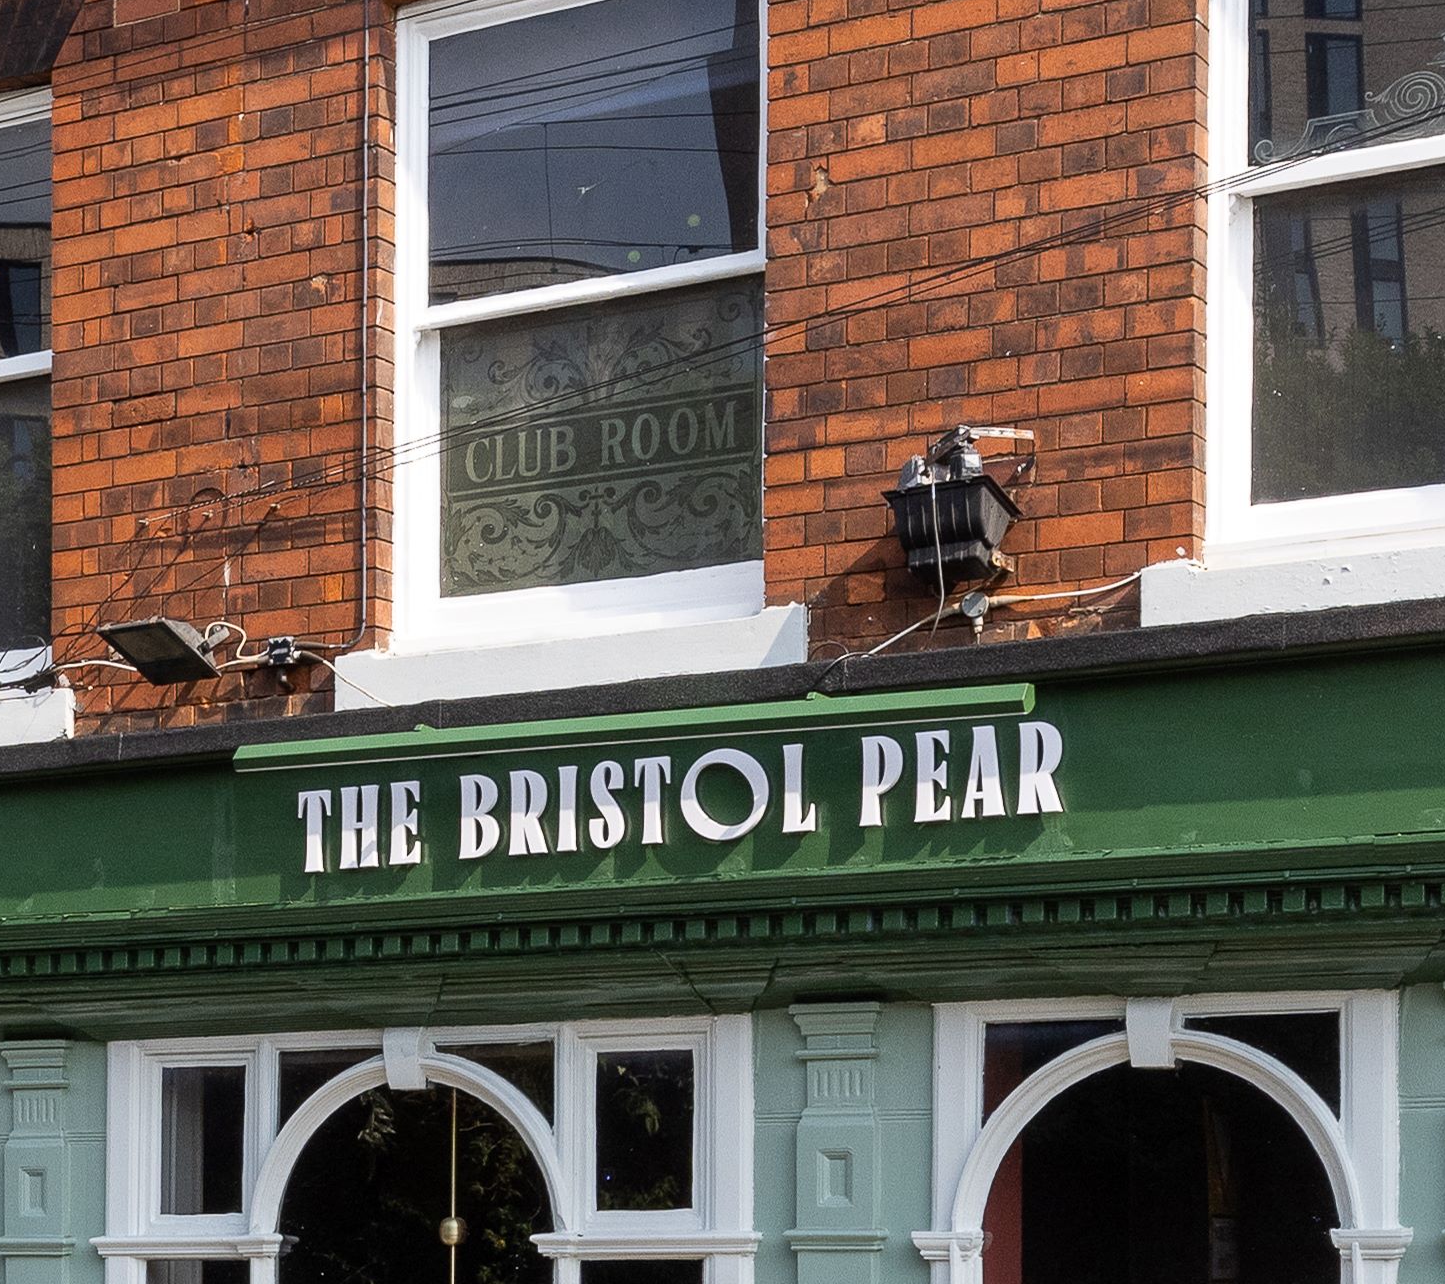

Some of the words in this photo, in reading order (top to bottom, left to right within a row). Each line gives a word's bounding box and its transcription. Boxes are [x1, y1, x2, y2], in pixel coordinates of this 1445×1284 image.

[465, 425, 578, 482] CLUB
[600, 400, 737, 466] ROOM
[297, 780, 422, 873] THE
[458, 744, 817, 861] BRISTOL
[860, 721, 1066, 827] PEAR
